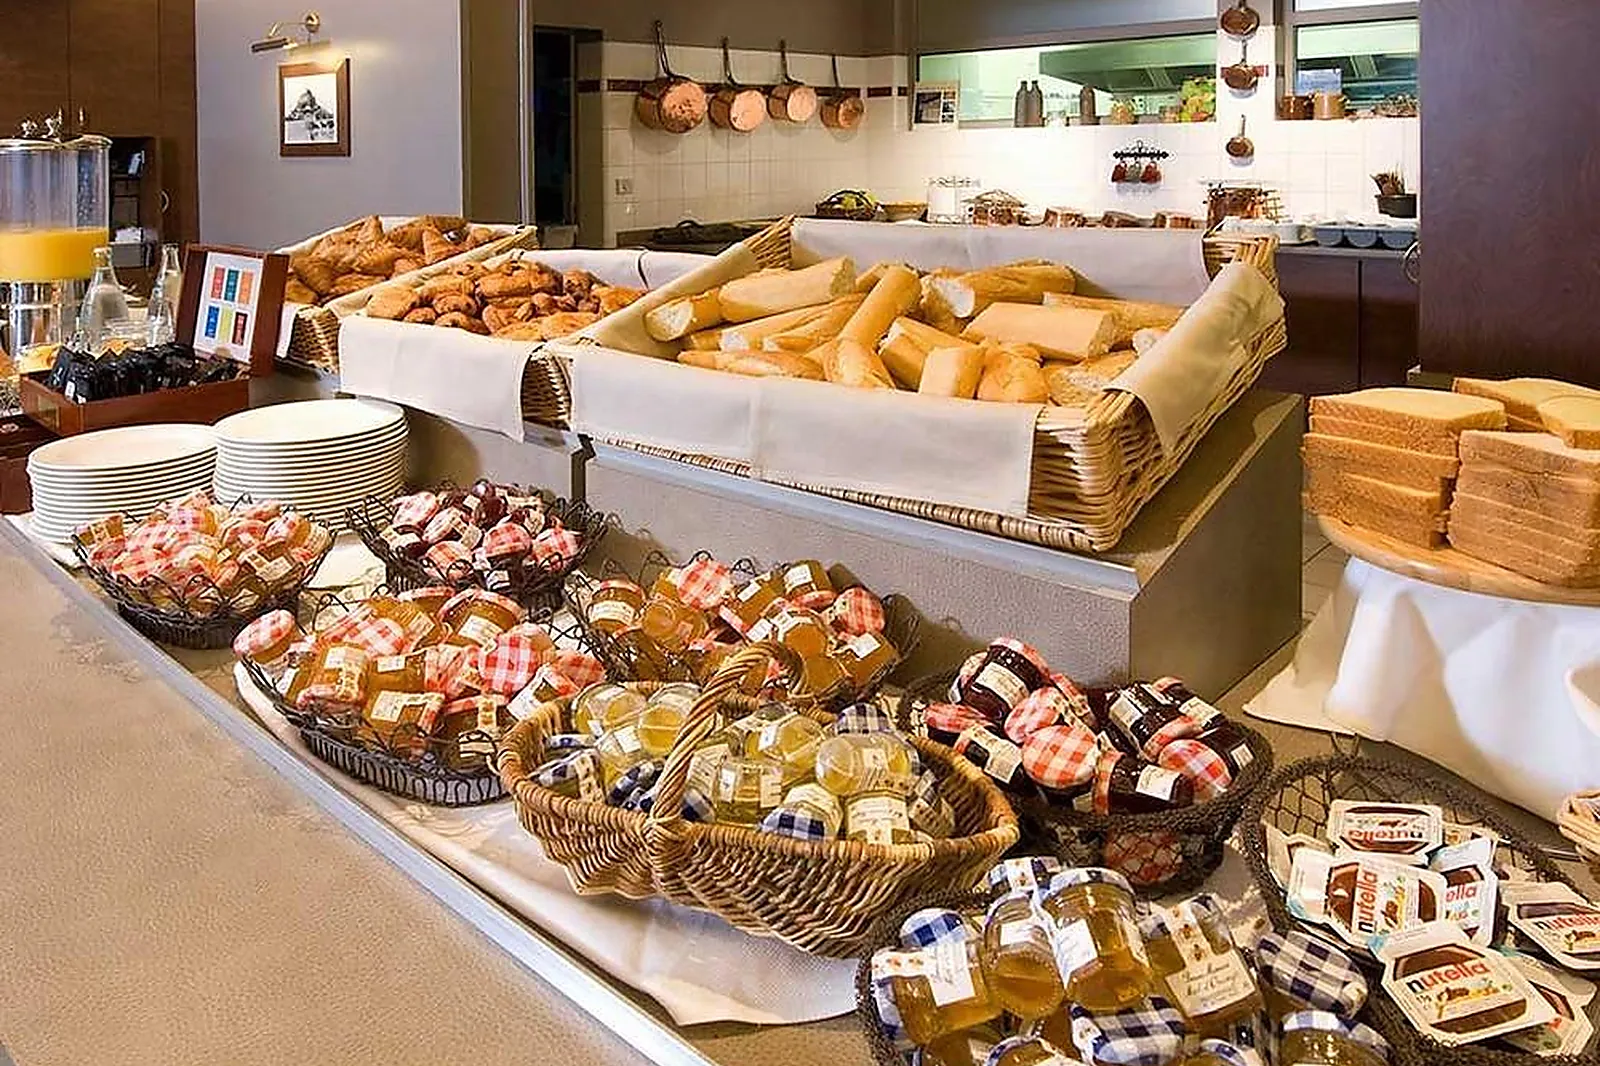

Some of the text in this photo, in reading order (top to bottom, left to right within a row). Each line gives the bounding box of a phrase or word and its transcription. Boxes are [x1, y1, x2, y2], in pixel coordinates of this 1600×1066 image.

[1349, 830, 1423, 845] nutella
[1357, 870, 1378, 933] nutella
[1406, 963, 1490, 993] nutella
